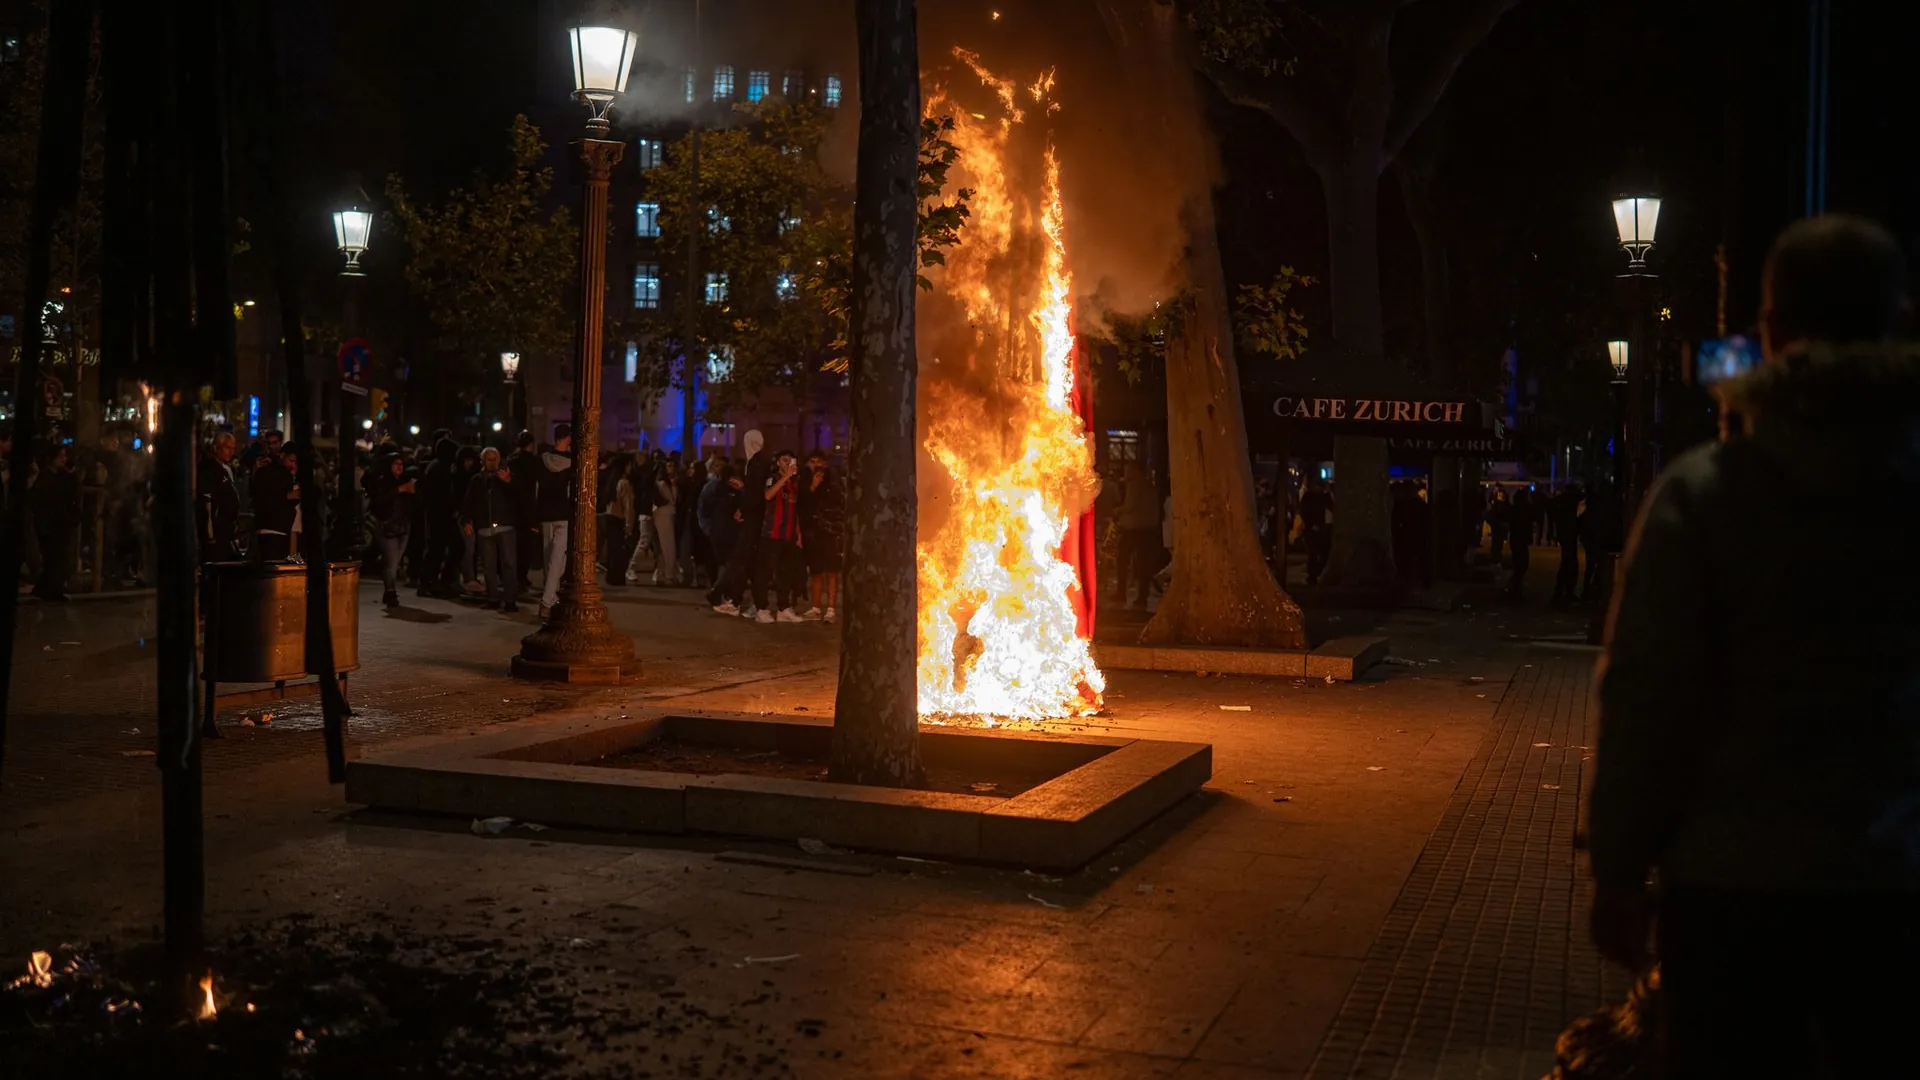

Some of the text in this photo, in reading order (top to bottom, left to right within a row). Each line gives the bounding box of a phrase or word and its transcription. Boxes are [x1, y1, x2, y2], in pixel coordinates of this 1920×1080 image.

[1273, 397, 1466, 422] CAFE ZURICH
[1442, 439, 1514, 452] ZURICH
